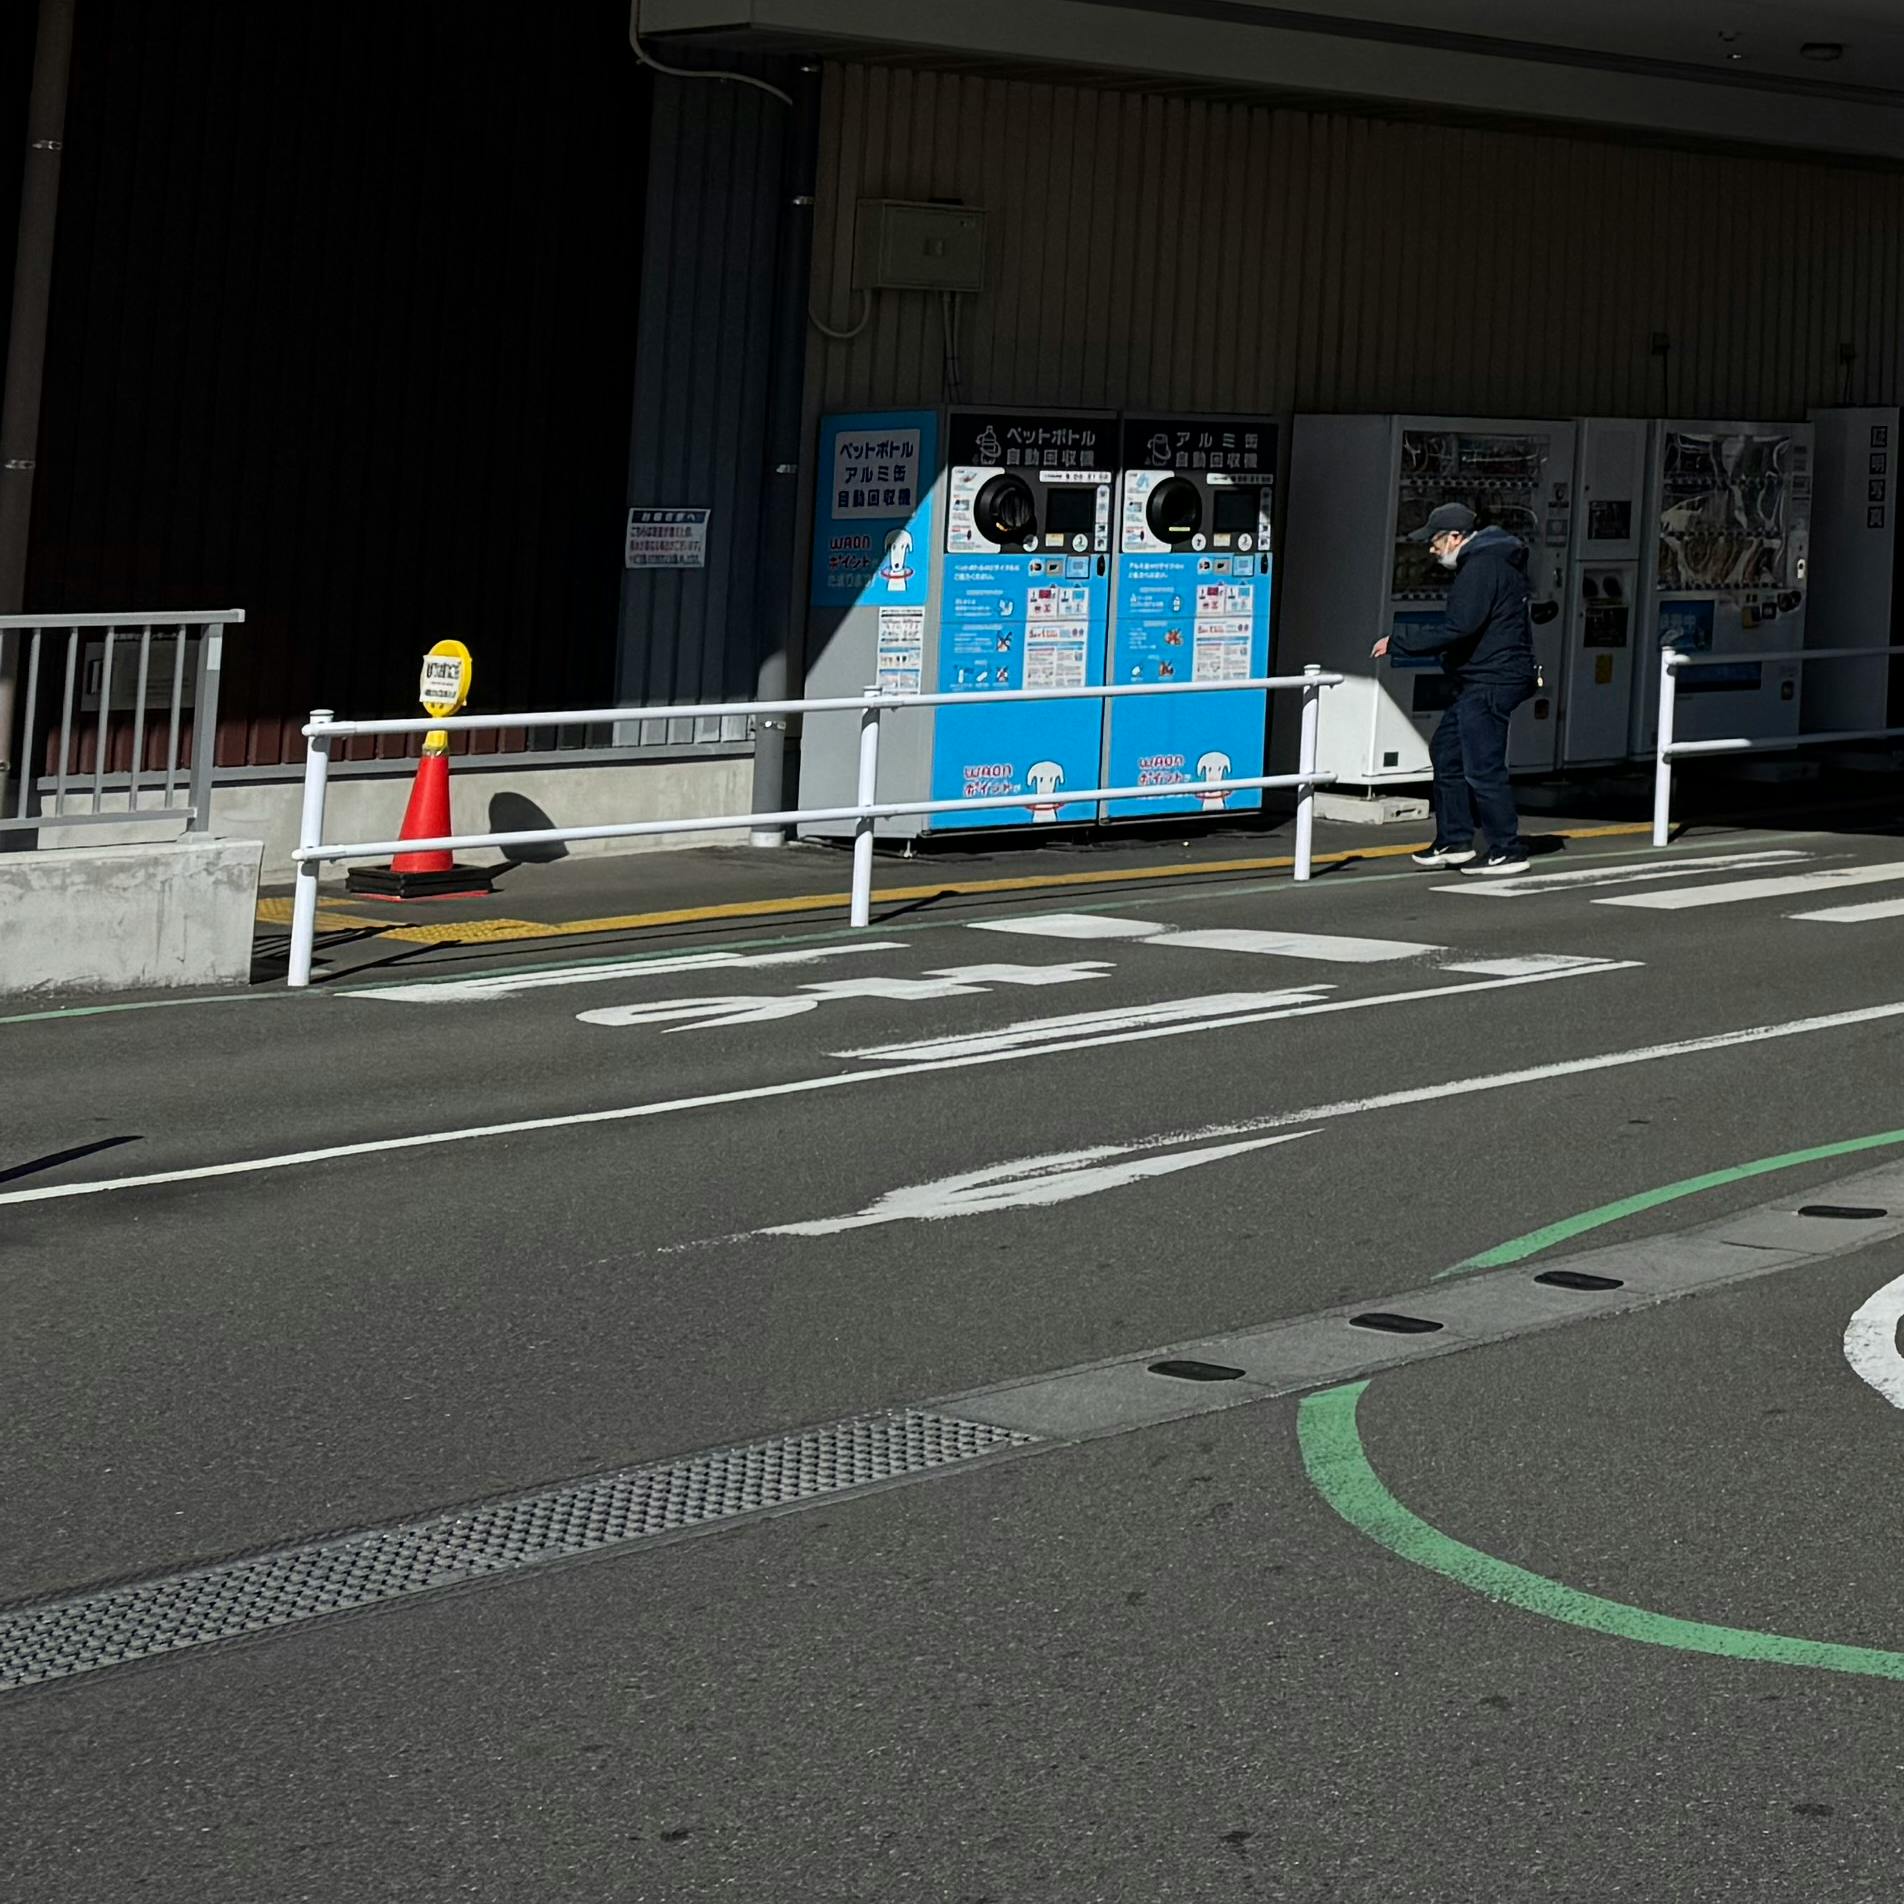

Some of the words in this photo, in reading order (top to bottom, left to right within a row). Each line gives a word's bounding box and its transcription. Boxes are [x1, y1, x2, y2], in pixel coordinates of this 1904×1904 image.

[1007, 428, 1096, 445] ペットボトル
[1176, 432, 1258, 448] アルミ缶
[840, 440, 914, 459] ペットボトル
[1006, 448, 1095, 467] 自動回収機
[1175, 452, 1258, 469] 自動回収機
[845, 464, 906, 484] アルミ缶
[838, 488, 911, 508] 自動回収機
